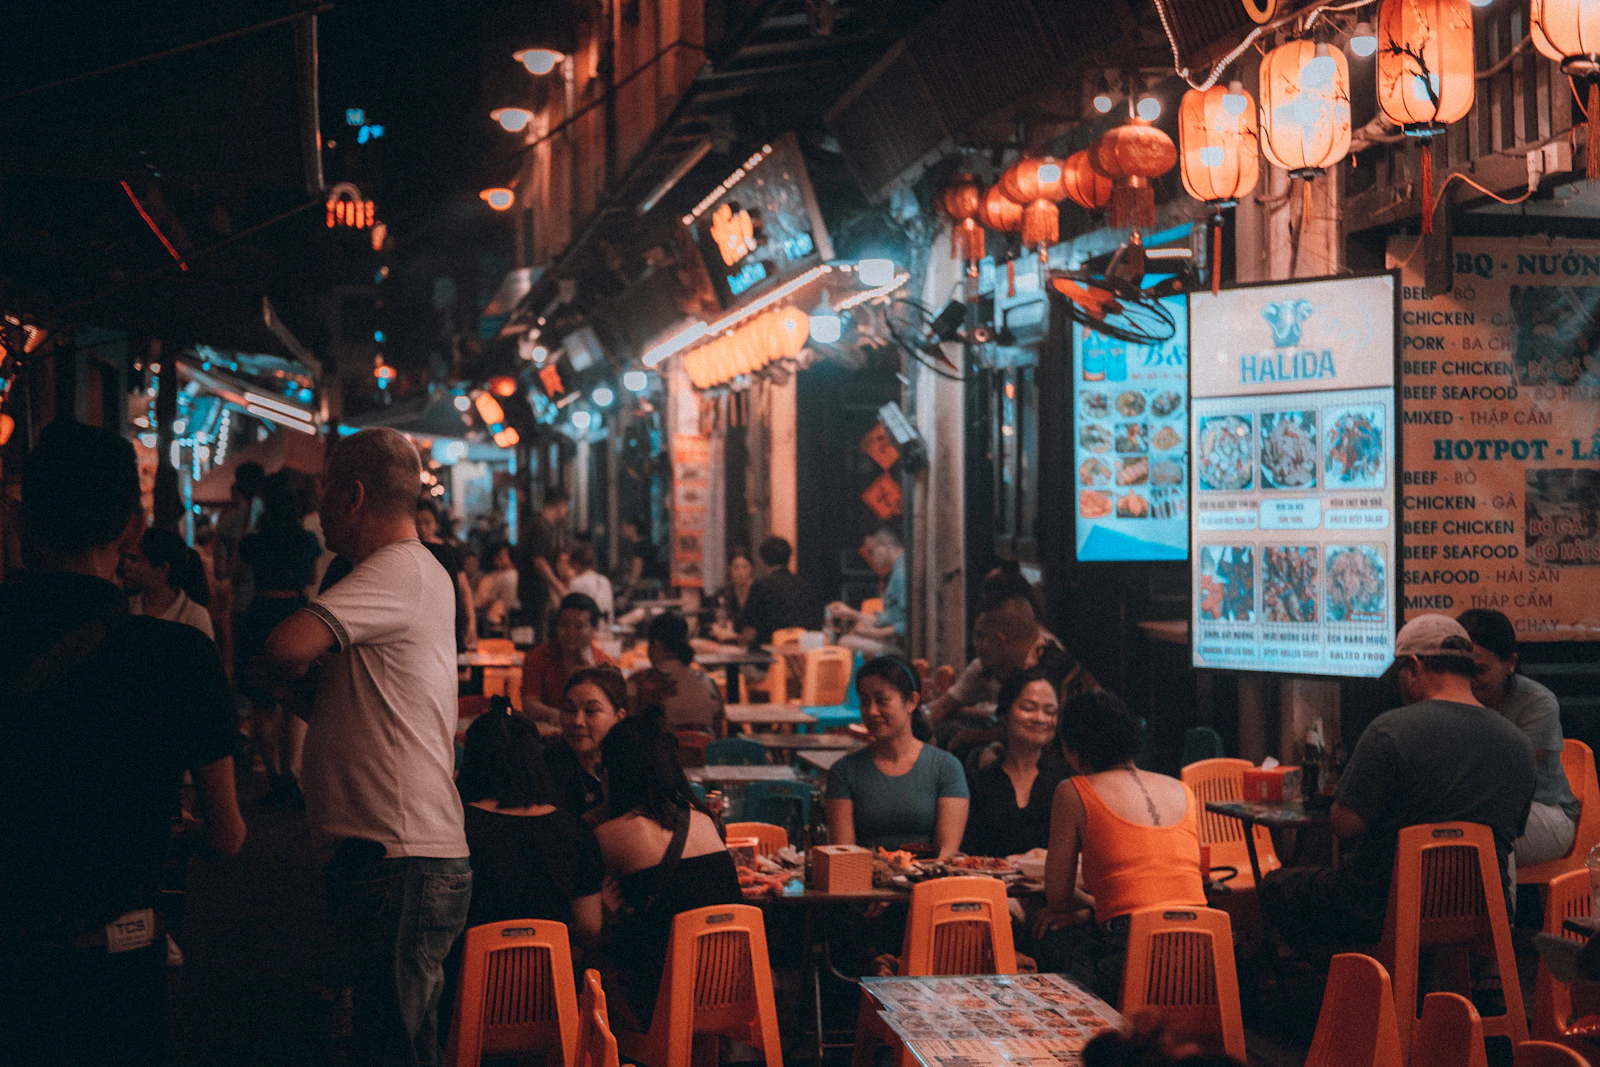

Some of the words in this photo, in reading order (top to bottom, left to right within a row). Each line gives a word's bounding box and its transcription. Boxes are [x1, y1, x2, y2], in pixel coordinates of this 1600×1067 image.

[1454, 252, 1494, 280] BQ
[1403, 311, 1476, 326] CHICKEN
[1403, 336, 1446, 351] PORK
[1462, 336, 1485, 351] BA
[1239, 348, 1338, 385] HALIDA
[1403, 361, 1437, 376] BEEF
[1441, 361, 1514, 376] CHICKEN
[1403, 386, 1437, 400] BEEF
[1441, 385, 1518, 401] SEAFOOD
[1403, 411, 1454, 425] MIXED
[1433, 439, 1549, 461] HOTPOT
[1403, 471, 1438, 485] BEEF
[1454, 467, 1477, 485] BÒ
[1403, 496, 1476, 510] CHICKEN
[1492, 492, 1517, 510] GÀ
[1403, 520, 1438, 535] BEEF
[1443, 520, 1515, 535] CHICKEN
[1403, 546, 1438, 560] BEEF
[1443, 545, 1519, 560] SEAFOOD
[1403, 570, 1480, 585] SEAFOOD
[1403, 595, 1454, 609] MIXED
[1514, 618, 1561, 633] CHAY
